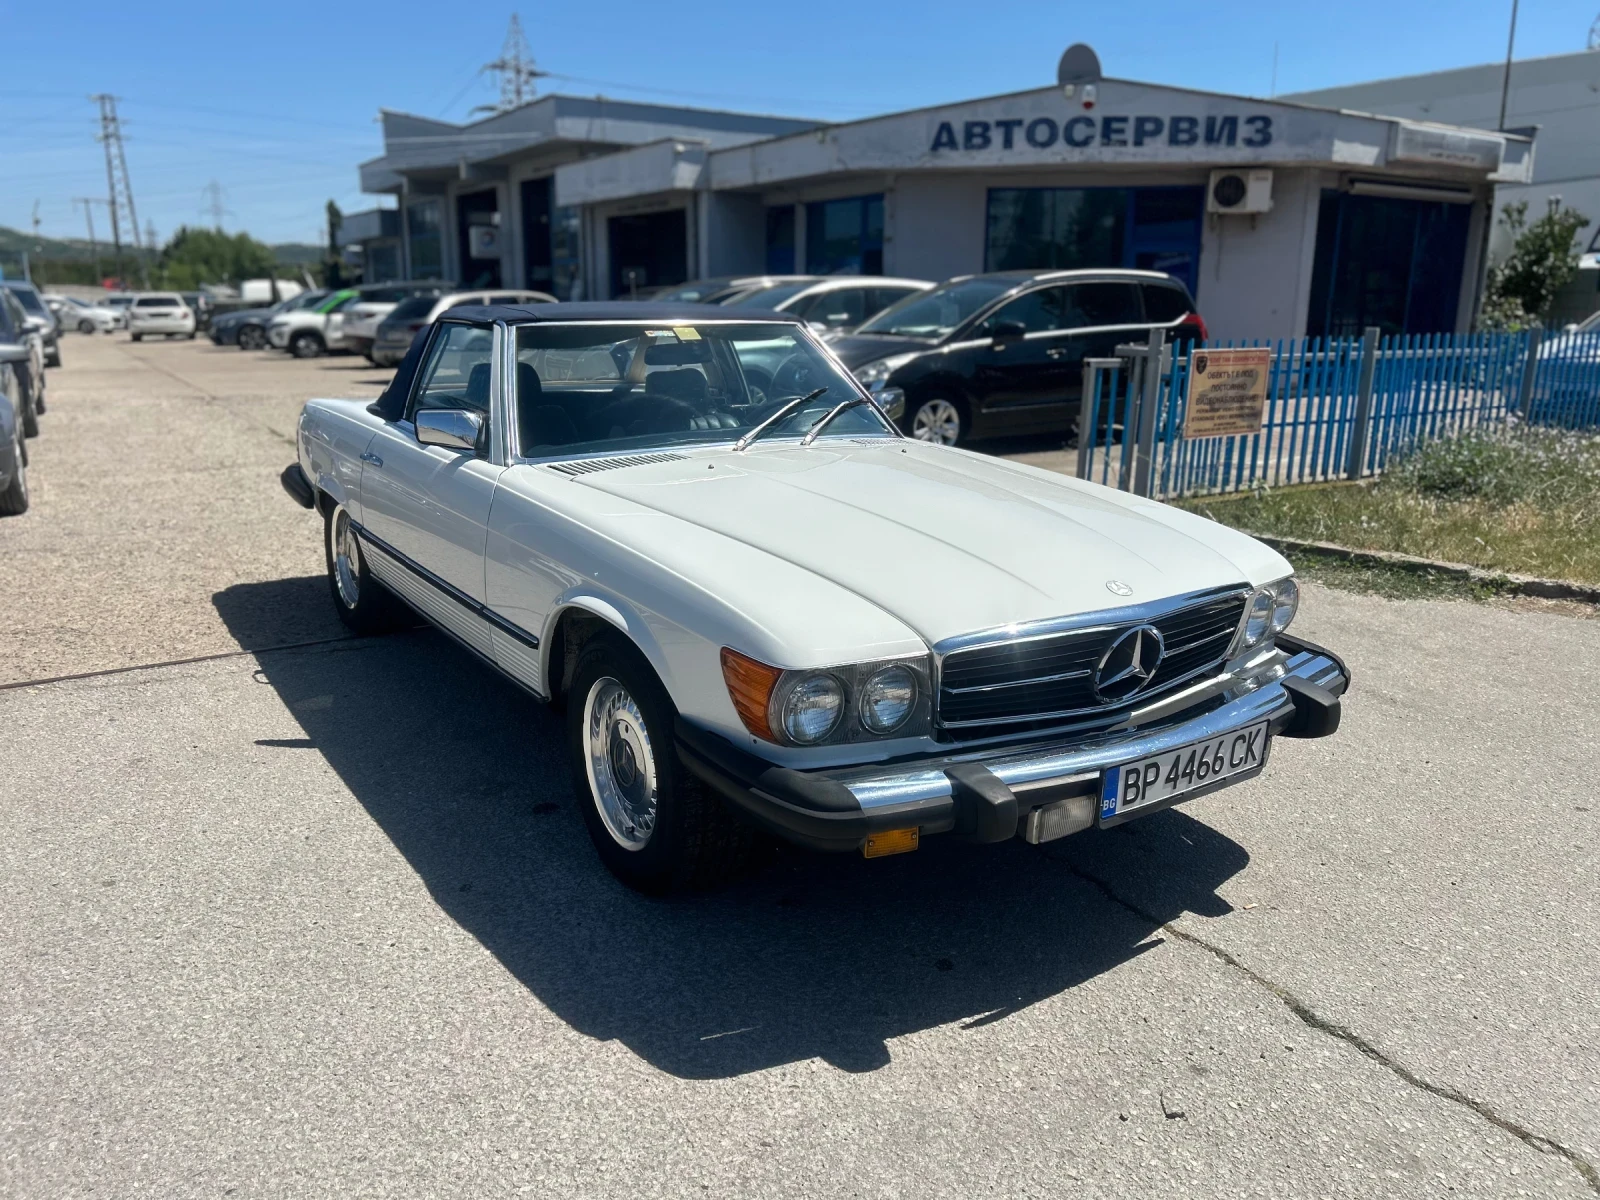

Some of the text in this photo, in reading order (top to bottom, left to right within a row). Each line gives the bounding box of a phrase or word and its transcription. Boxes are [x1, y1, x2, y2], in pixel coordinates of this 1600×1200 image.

[930, 115, 1274, 153] АВТОСЕРВИЗ
[1207, 370, 1234, 379] ОБЕКТЪТ
[1210, 383, 1248, 392] ПОСТОЯННО
[1122, 728, 1262, 806] BP 4466 CK
[1102, 797, 1116, 811] BG
